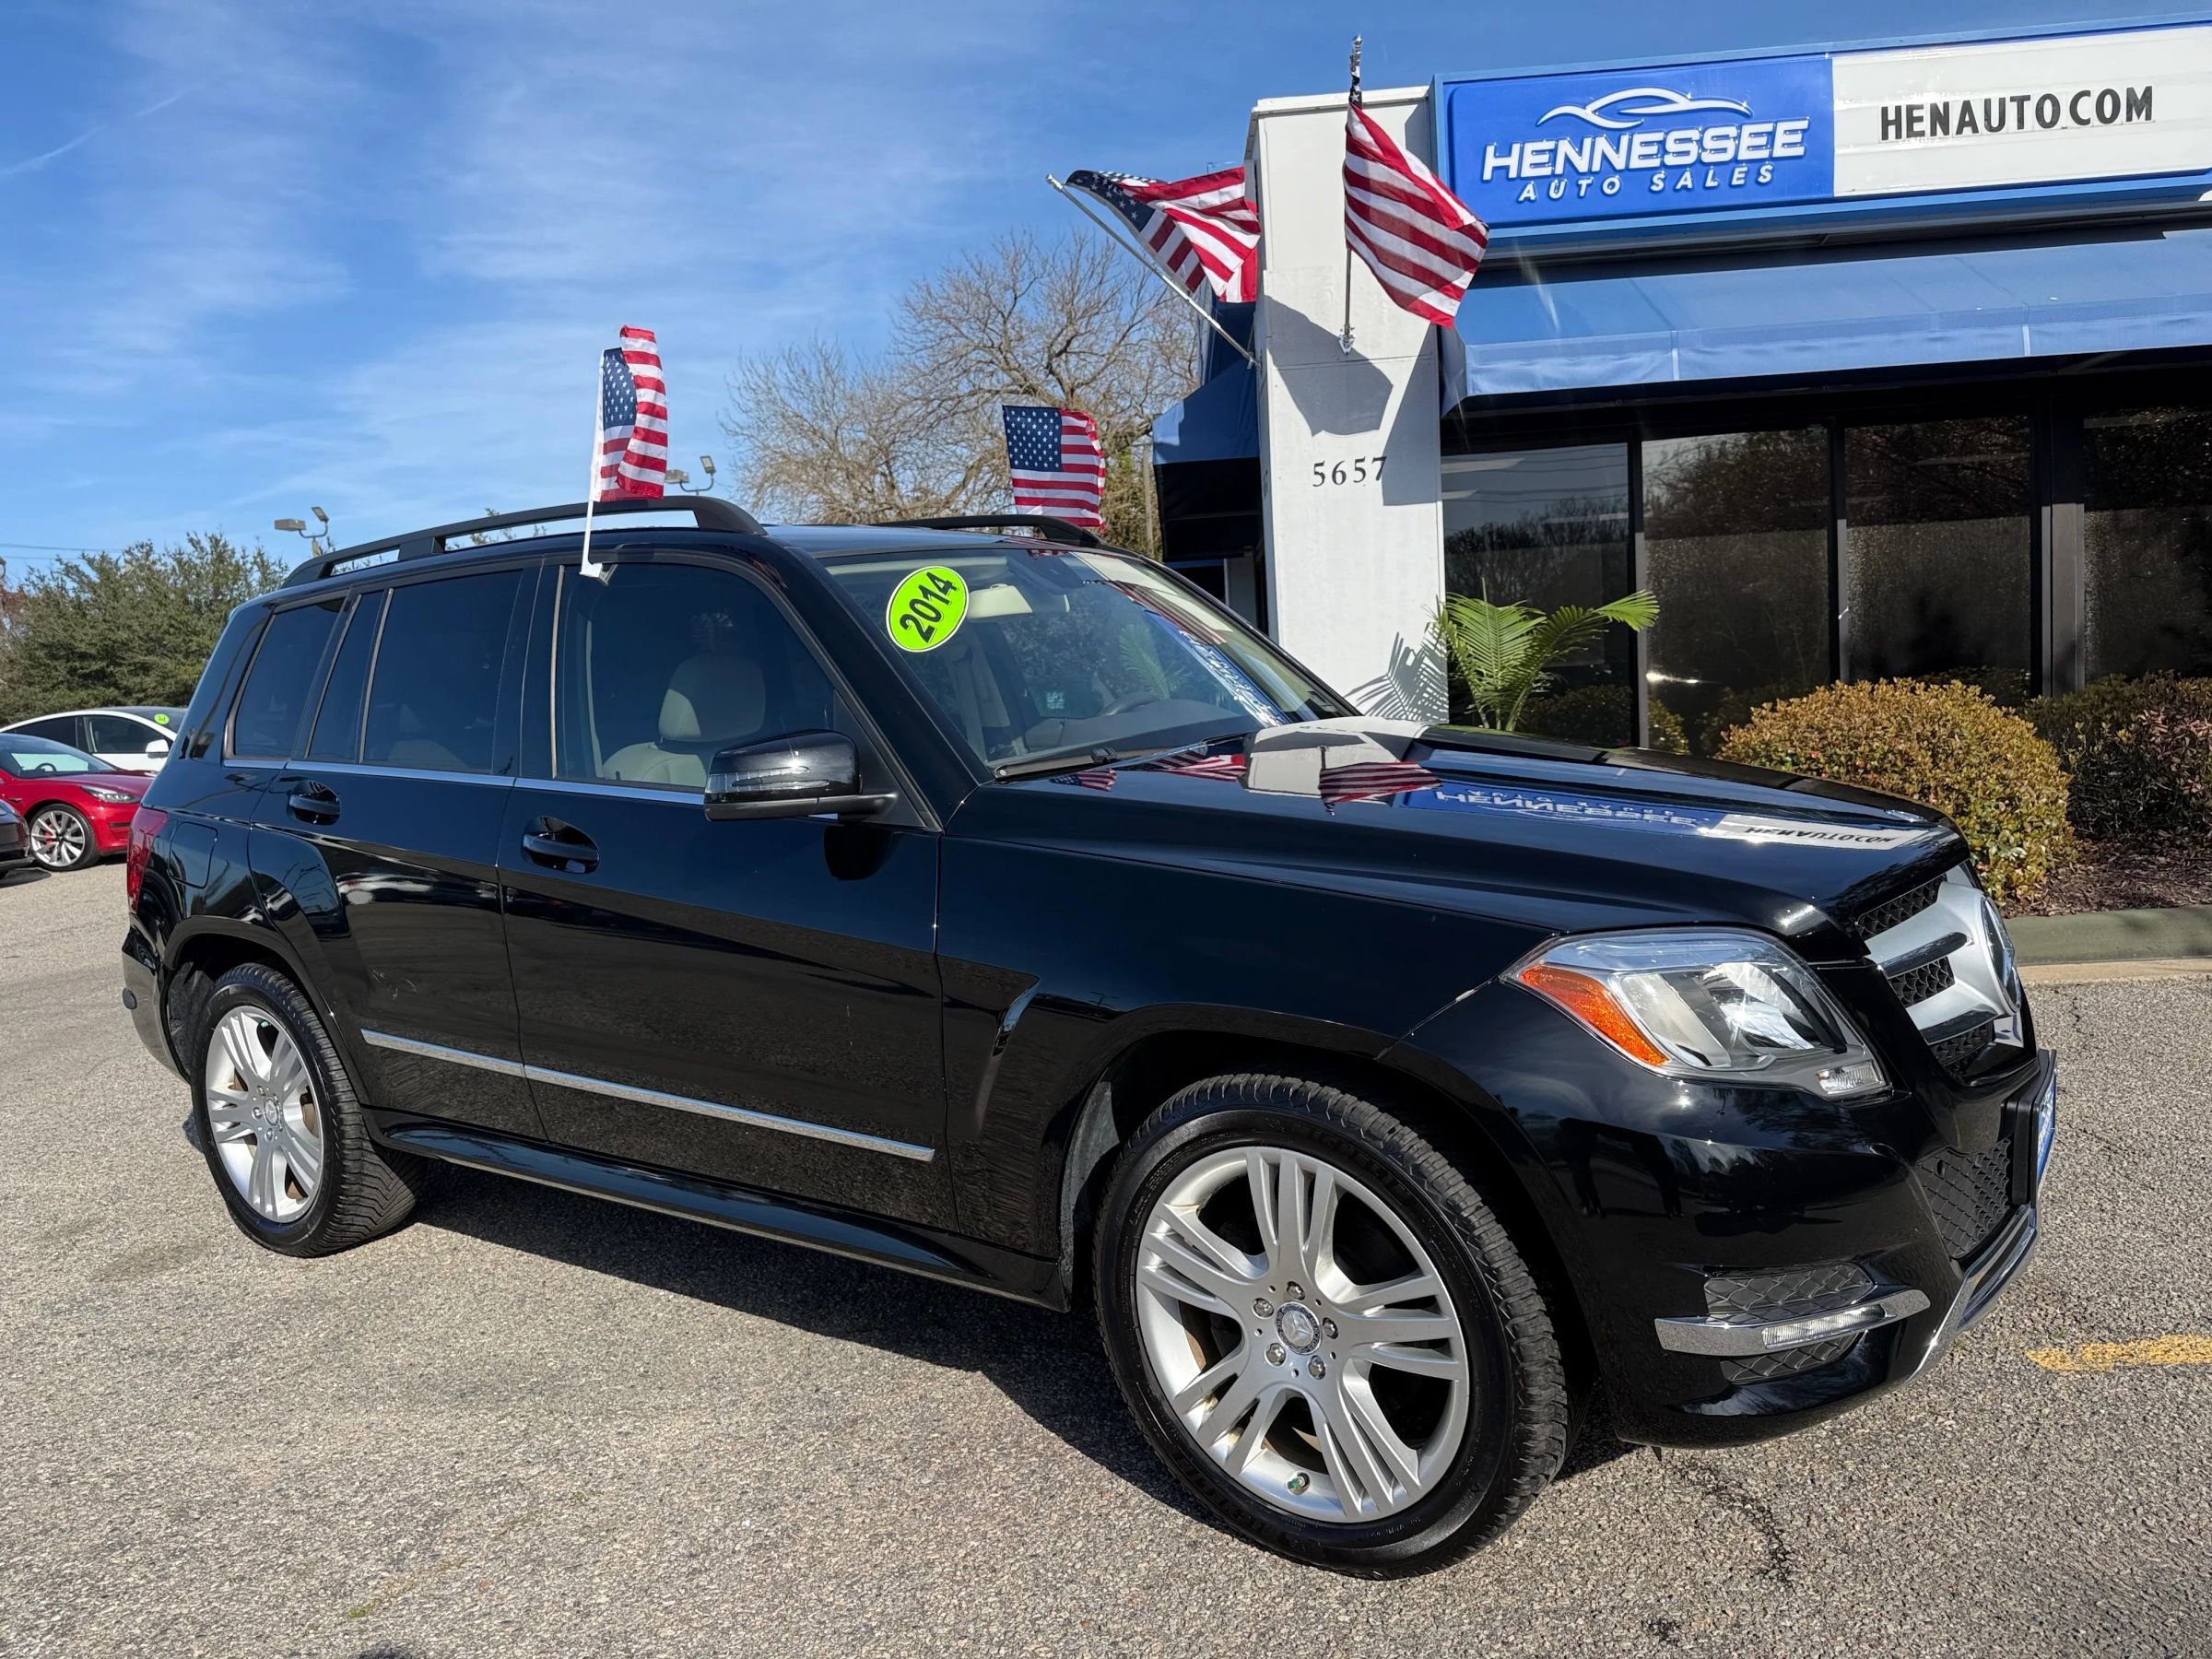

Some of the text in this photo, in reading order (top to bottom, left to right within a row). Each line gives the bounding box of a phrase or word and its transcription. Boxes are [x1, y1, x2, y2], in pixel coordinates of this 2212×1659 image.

[1481, 118, 1809, 181] HENNESSEE
[1519, 161, 1774, 202] AUTO SALES
[1312, 455, 1387, 488] 5657
[899, 571, 959, 643] 2014
